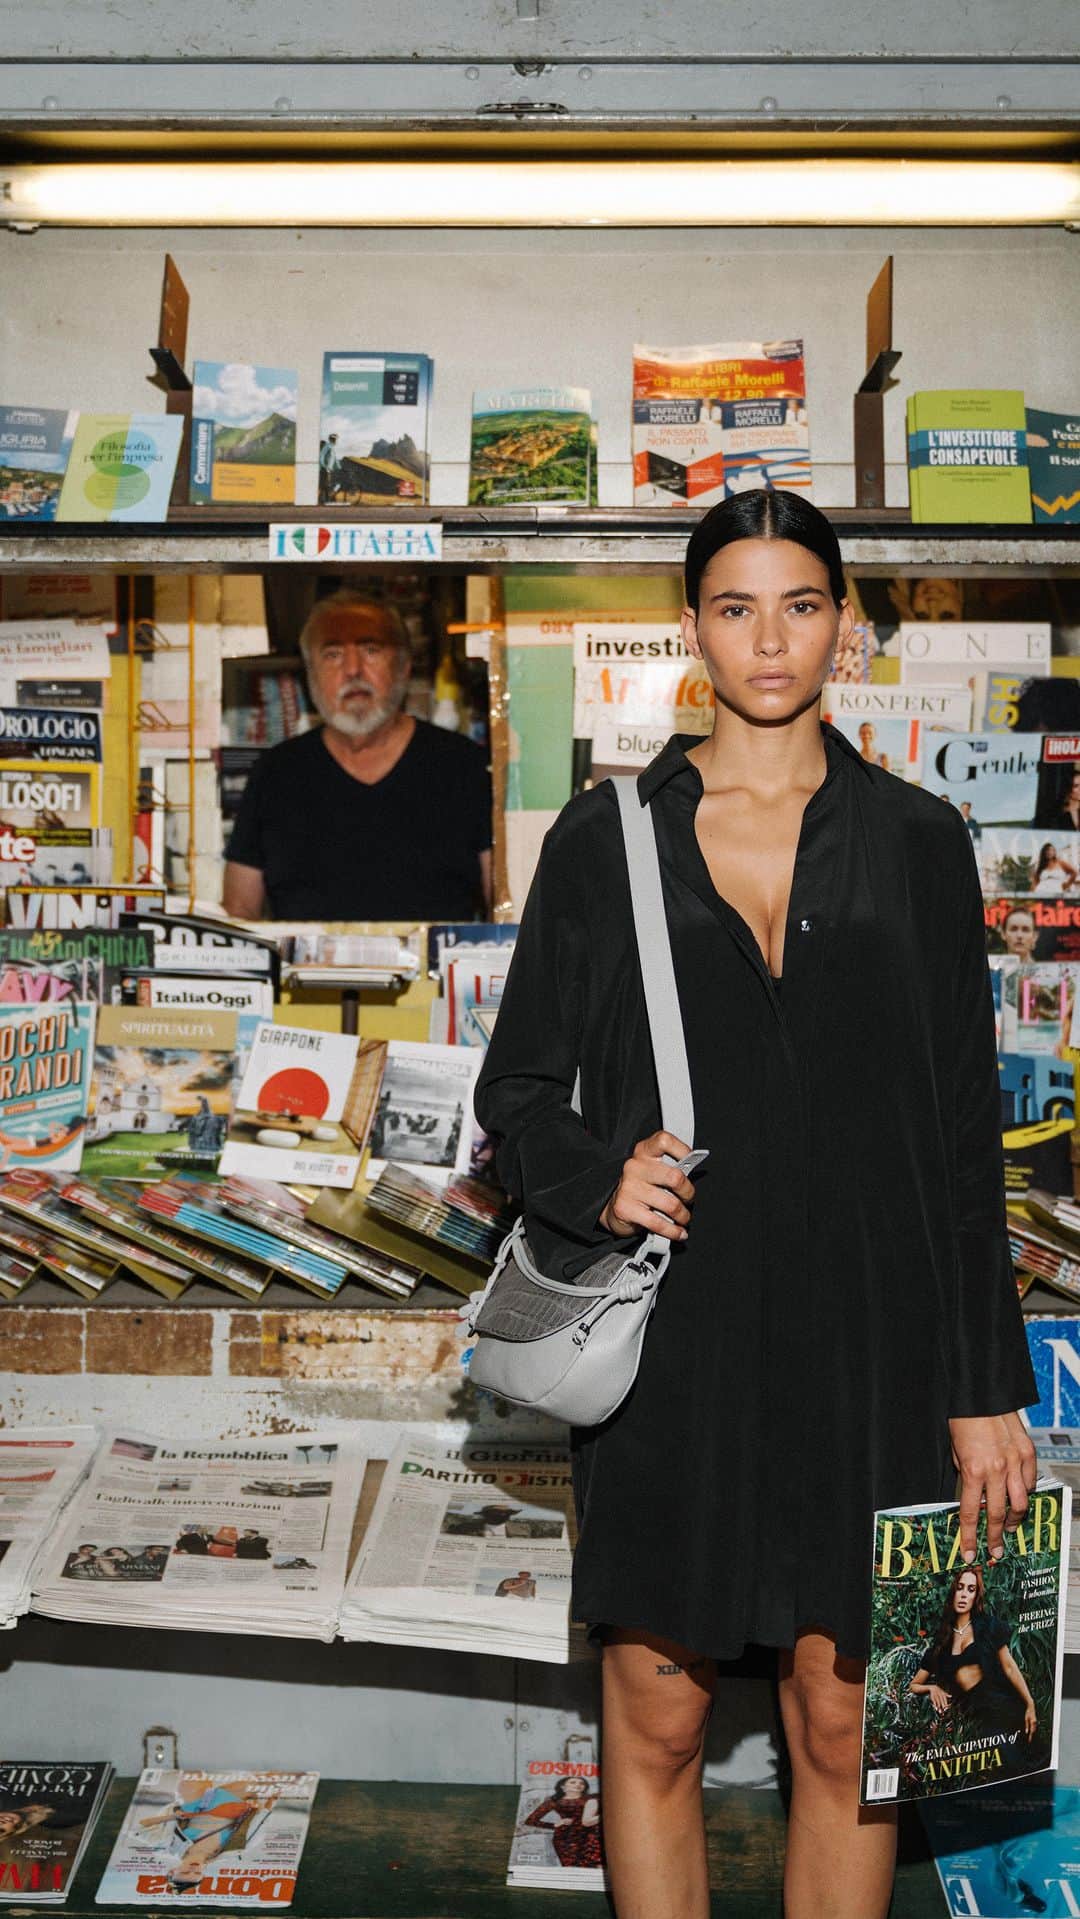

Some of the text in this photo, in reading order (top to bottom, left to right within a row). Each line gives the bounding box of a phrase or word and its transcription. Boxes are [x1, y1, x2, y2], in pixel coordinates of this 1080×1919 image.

[671, 376, 730, 388] Raffaele
[735, 371, 785, 386] Morelli
[928, 430, 1017, 447] L'INVESTITORE
[929, 448, 1018, 466] CONSAPEVOLE
[333, 529, 437, 556] ITALIA
[839, 691, 949, 713] KONFEKT
[0, 710, 96, 741] ROLOGIO
[935, 741, 1040, 783] Gentle
[156, 991, 252, 1008] ItaliaOggi
[260, 1028, 324, 1052] GIAPPONE
[182, 1449, 289, 1462] Repubblica
[400, 1461, 498, 1486] PARTITO
[880, 1496, 1060, 1578] BAZAR
[1019, 1607, 1055, 1622] FREEING
[1030, 1618, 1055, 1631] FRIZZ
[904, 1730, 1021, 1763] The EMANCIPATION of
[923, 1748, 1003, 1782] ANITTA
[219, 1868, 298, 1878] moderna
